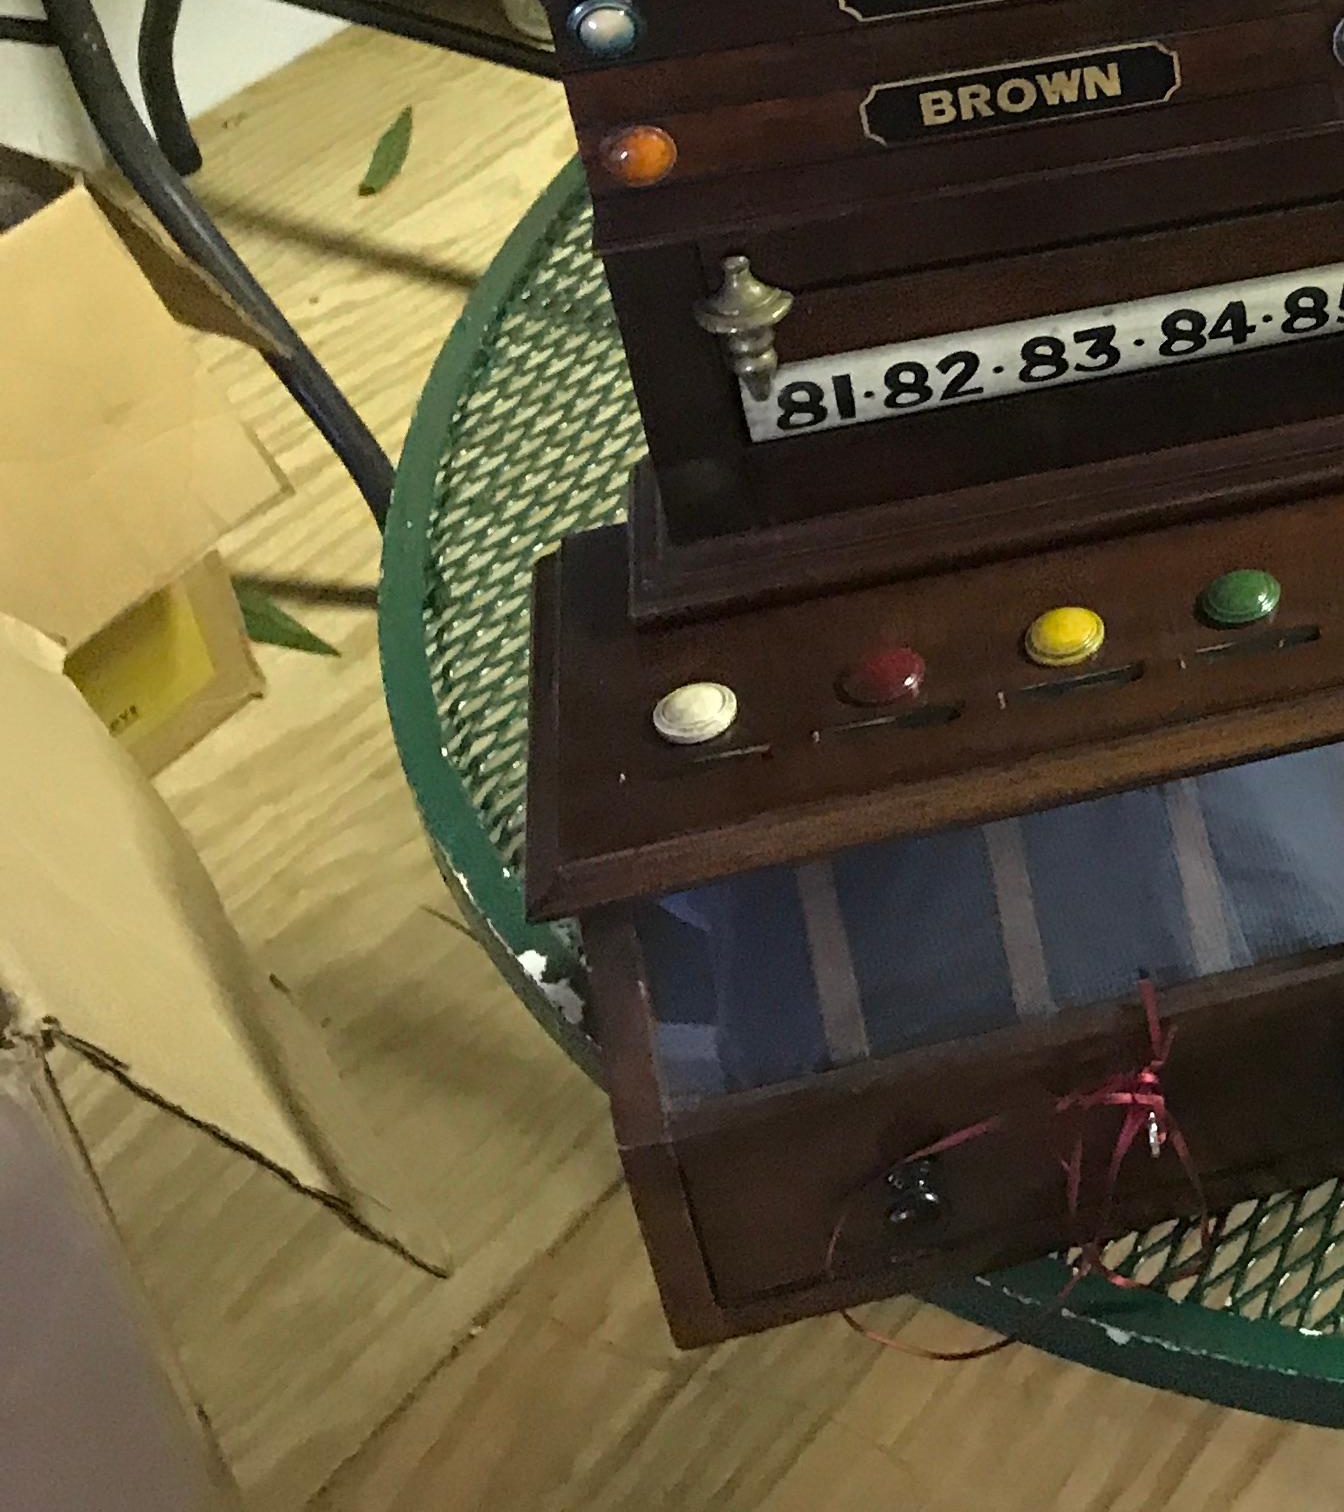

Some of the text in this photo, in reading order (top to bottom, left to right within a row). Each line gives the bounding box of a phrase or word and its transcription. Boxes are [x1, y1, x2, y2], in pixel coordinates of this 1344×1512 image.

[918, 62, 1122, 127] BROWN
[776, 374, 858, 431] 81
[882, 350, 984, 410] 82
[1017, 324, 1122, 385] 83
[1158, 299, 1256, 358] 84
